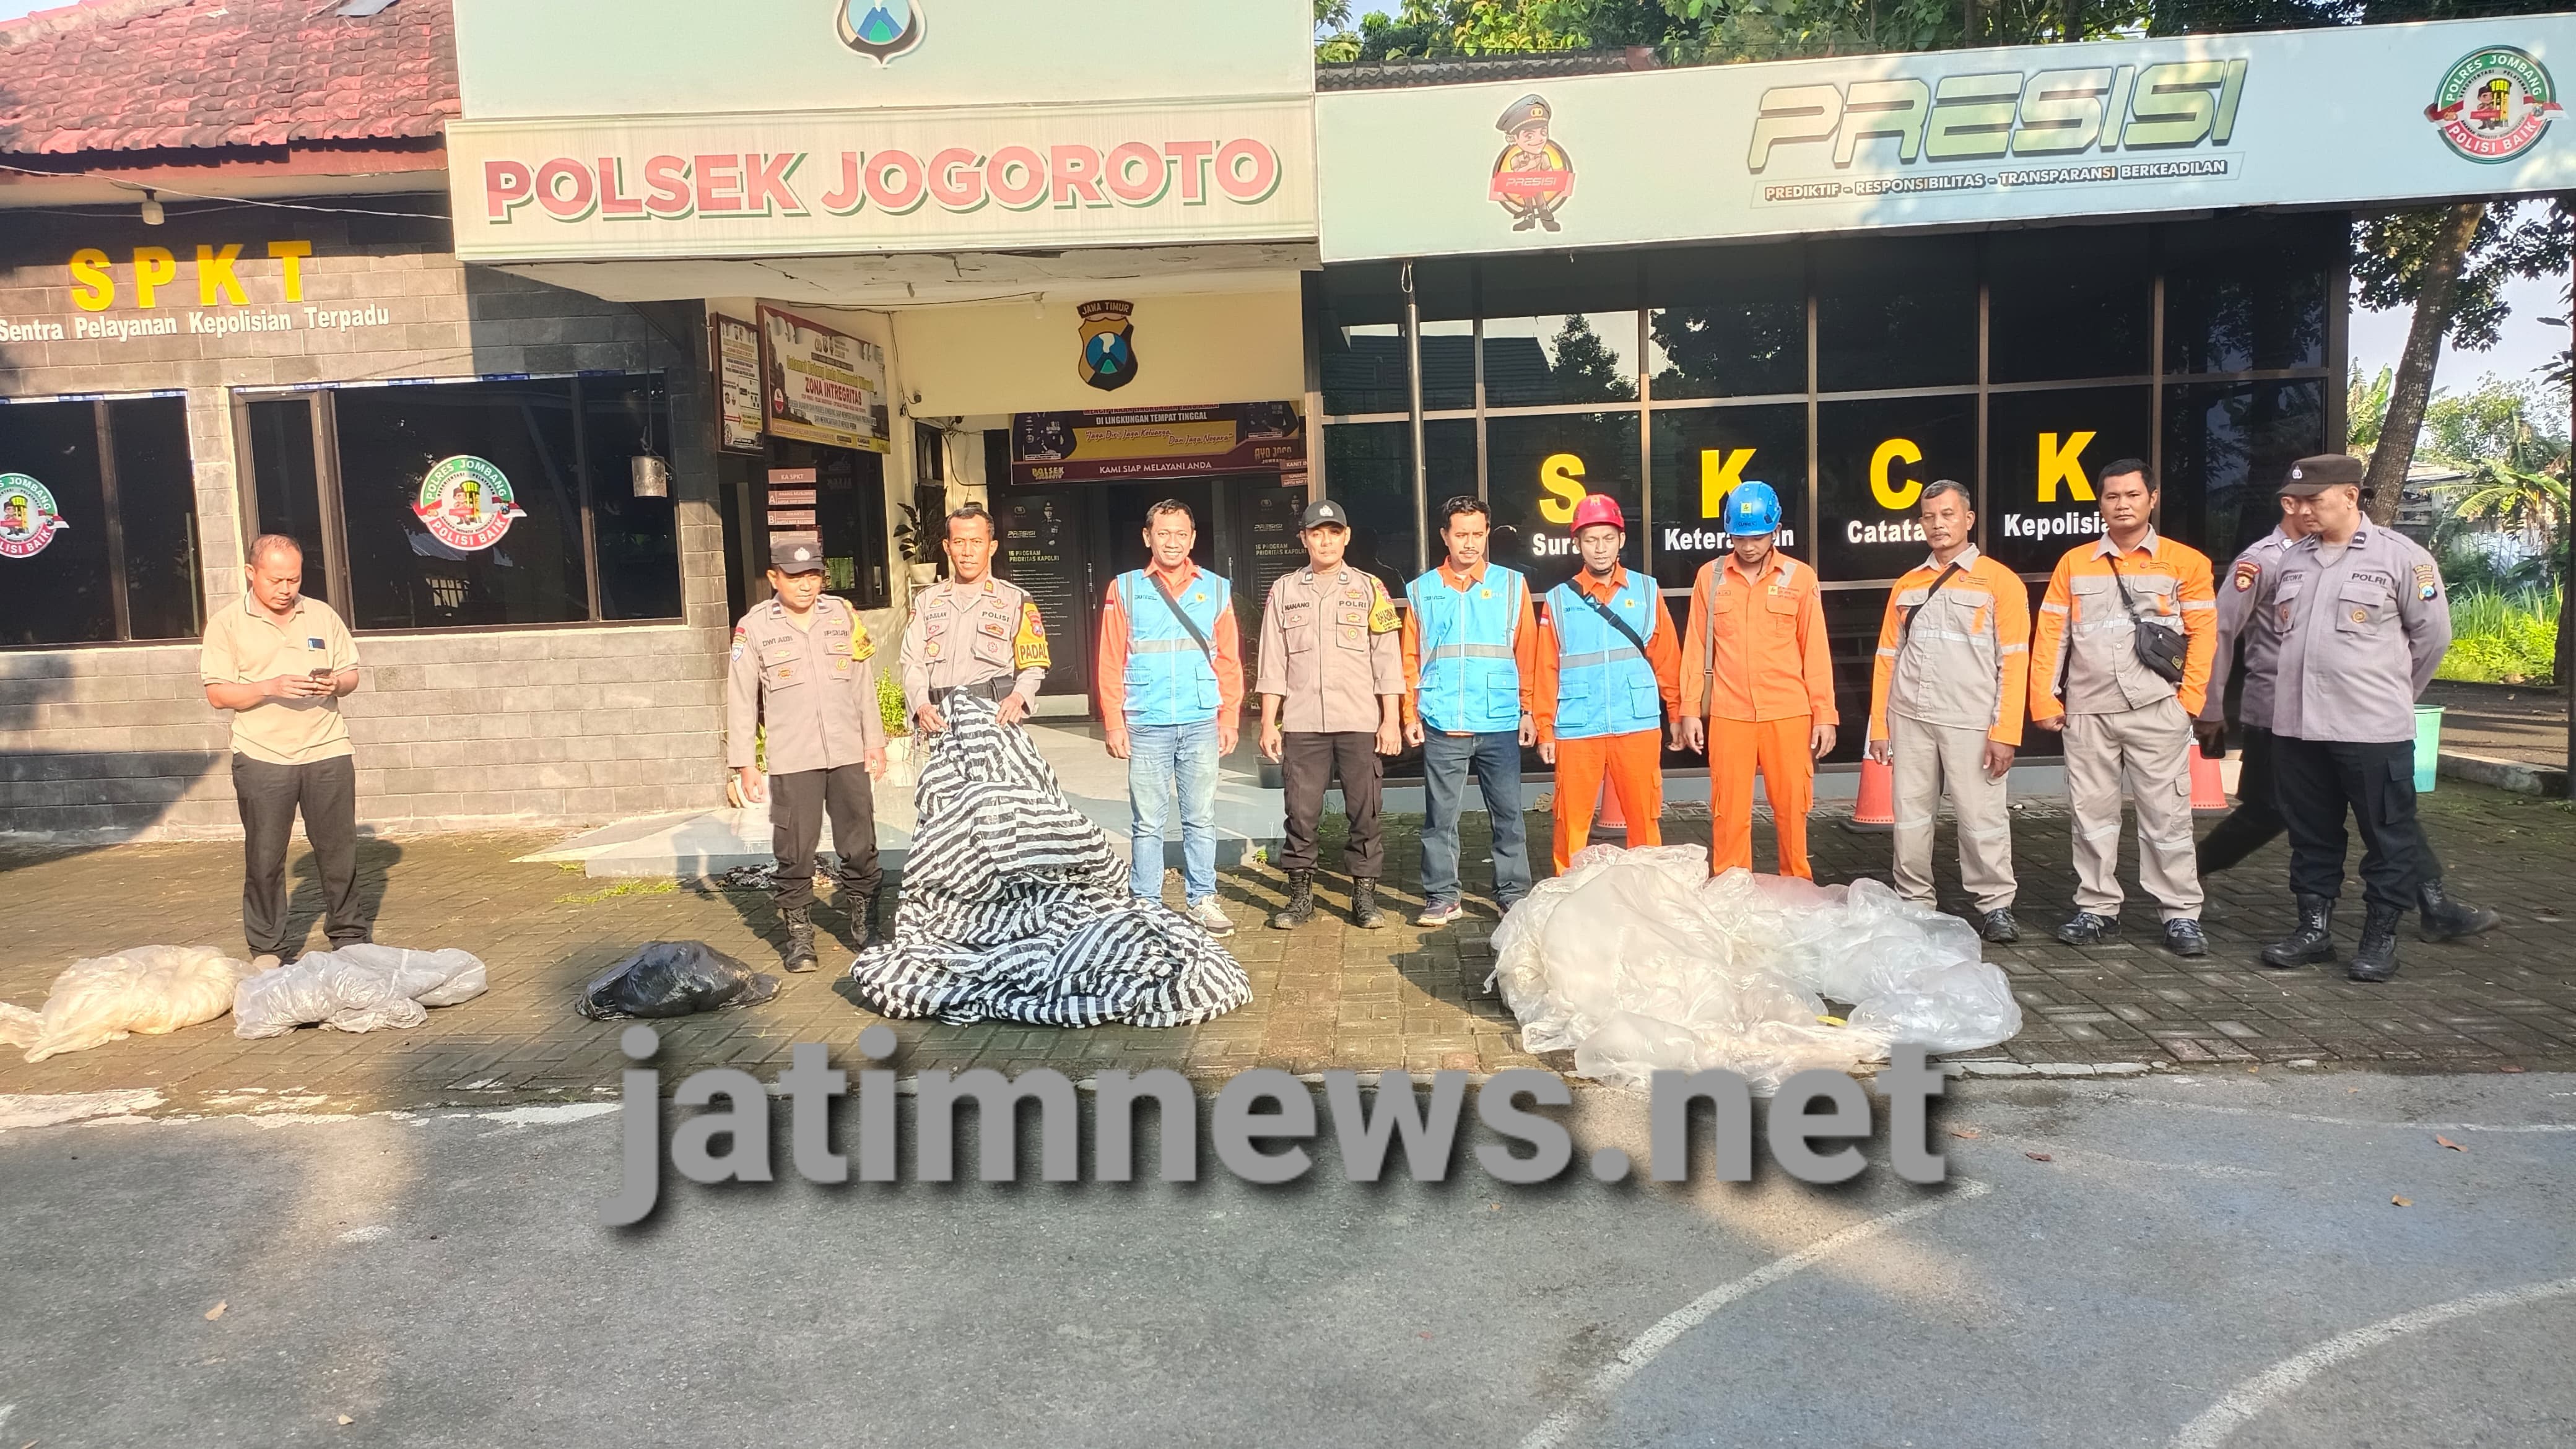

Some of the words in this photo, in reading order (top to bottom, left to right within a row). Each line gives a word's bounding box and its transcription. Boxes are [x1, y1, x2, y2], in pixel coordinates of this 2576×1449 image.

[2446, 59, 2482, 102] POLRES
[2489, 55, 2542, 96] JOMBANG
[1747, 59, 2247, 174] PRESISI
[2448, 125, 2496, 153] POLISI
[2503, 121, 2537, 150] BAIK
[485, 153, 810, 224] POLSEK
[820, 138, 1281, 216] JOGOROTO
[1506, 177, 1557, 186] PRESISI
[1765, 184, 1842, 201] PREDIKTIF
[1855, 174, 1985, 196] RESPONSIBILITAS
[1999, 167, 2116, 186] TRANSPARANSI
[2120, 160, 2227, 179] BERKEADILAN
[69, 240, 311, 311] SPKT
[1082, 302, 1101, 315] JAWA
[1105, 302, 1129, 312] TIMUR
[0, 320, 63, 342] Sentra
[75, 315, 177, 342] Pelayanan
[189, 309, 292, 338] Kepolisian
[303, 304, 389, 333] Terpadu
[805, 376, 823, 396] ZONA
[1105, 415, 1149, 424] LINGKUNGAN
[1150, 413, 1177, 422] TEMPAT
[1178, 412, 1208, 420] TINGGAL
[1121, 429, 1138, 440] Jaga
[1168, 435, 1183, 445] Dan
[1185, 435, 1201, 445] Jaga
[1032, 466, 1064, 476] POLSEK
[1099, 466, 1121, 474] KAMI
[1123, 464, 1141, 472] SIAP
[1144, 463, 1186, 472] MELAYANI
[426, 463, 455, 499] POLRES
[459, 460, 507, 497] JOMBANG
[9, 477, 51, 510] JOMBANG
[768, 495, 775, 503] A
[768, 515, 774, 523] B
[27, 529, 51, 551] BAIK
[432, 521, 474, 545] POLISI
[478, 518, 506, 544] BAIK
[1533, 533, 1581, 555] Sur
[1848, 519, 1927, 543] Catata
[2004, 511, 2110, 541] Kepolisia
[2352, 573, 2387, 585] POLRI
[1339, 600, 1367, 608] POLRI
[981, 611, 1009, 622] POLISI
[762, 638, 776, 646] DWI
[1019, 643, 1047, 661] PADAL
